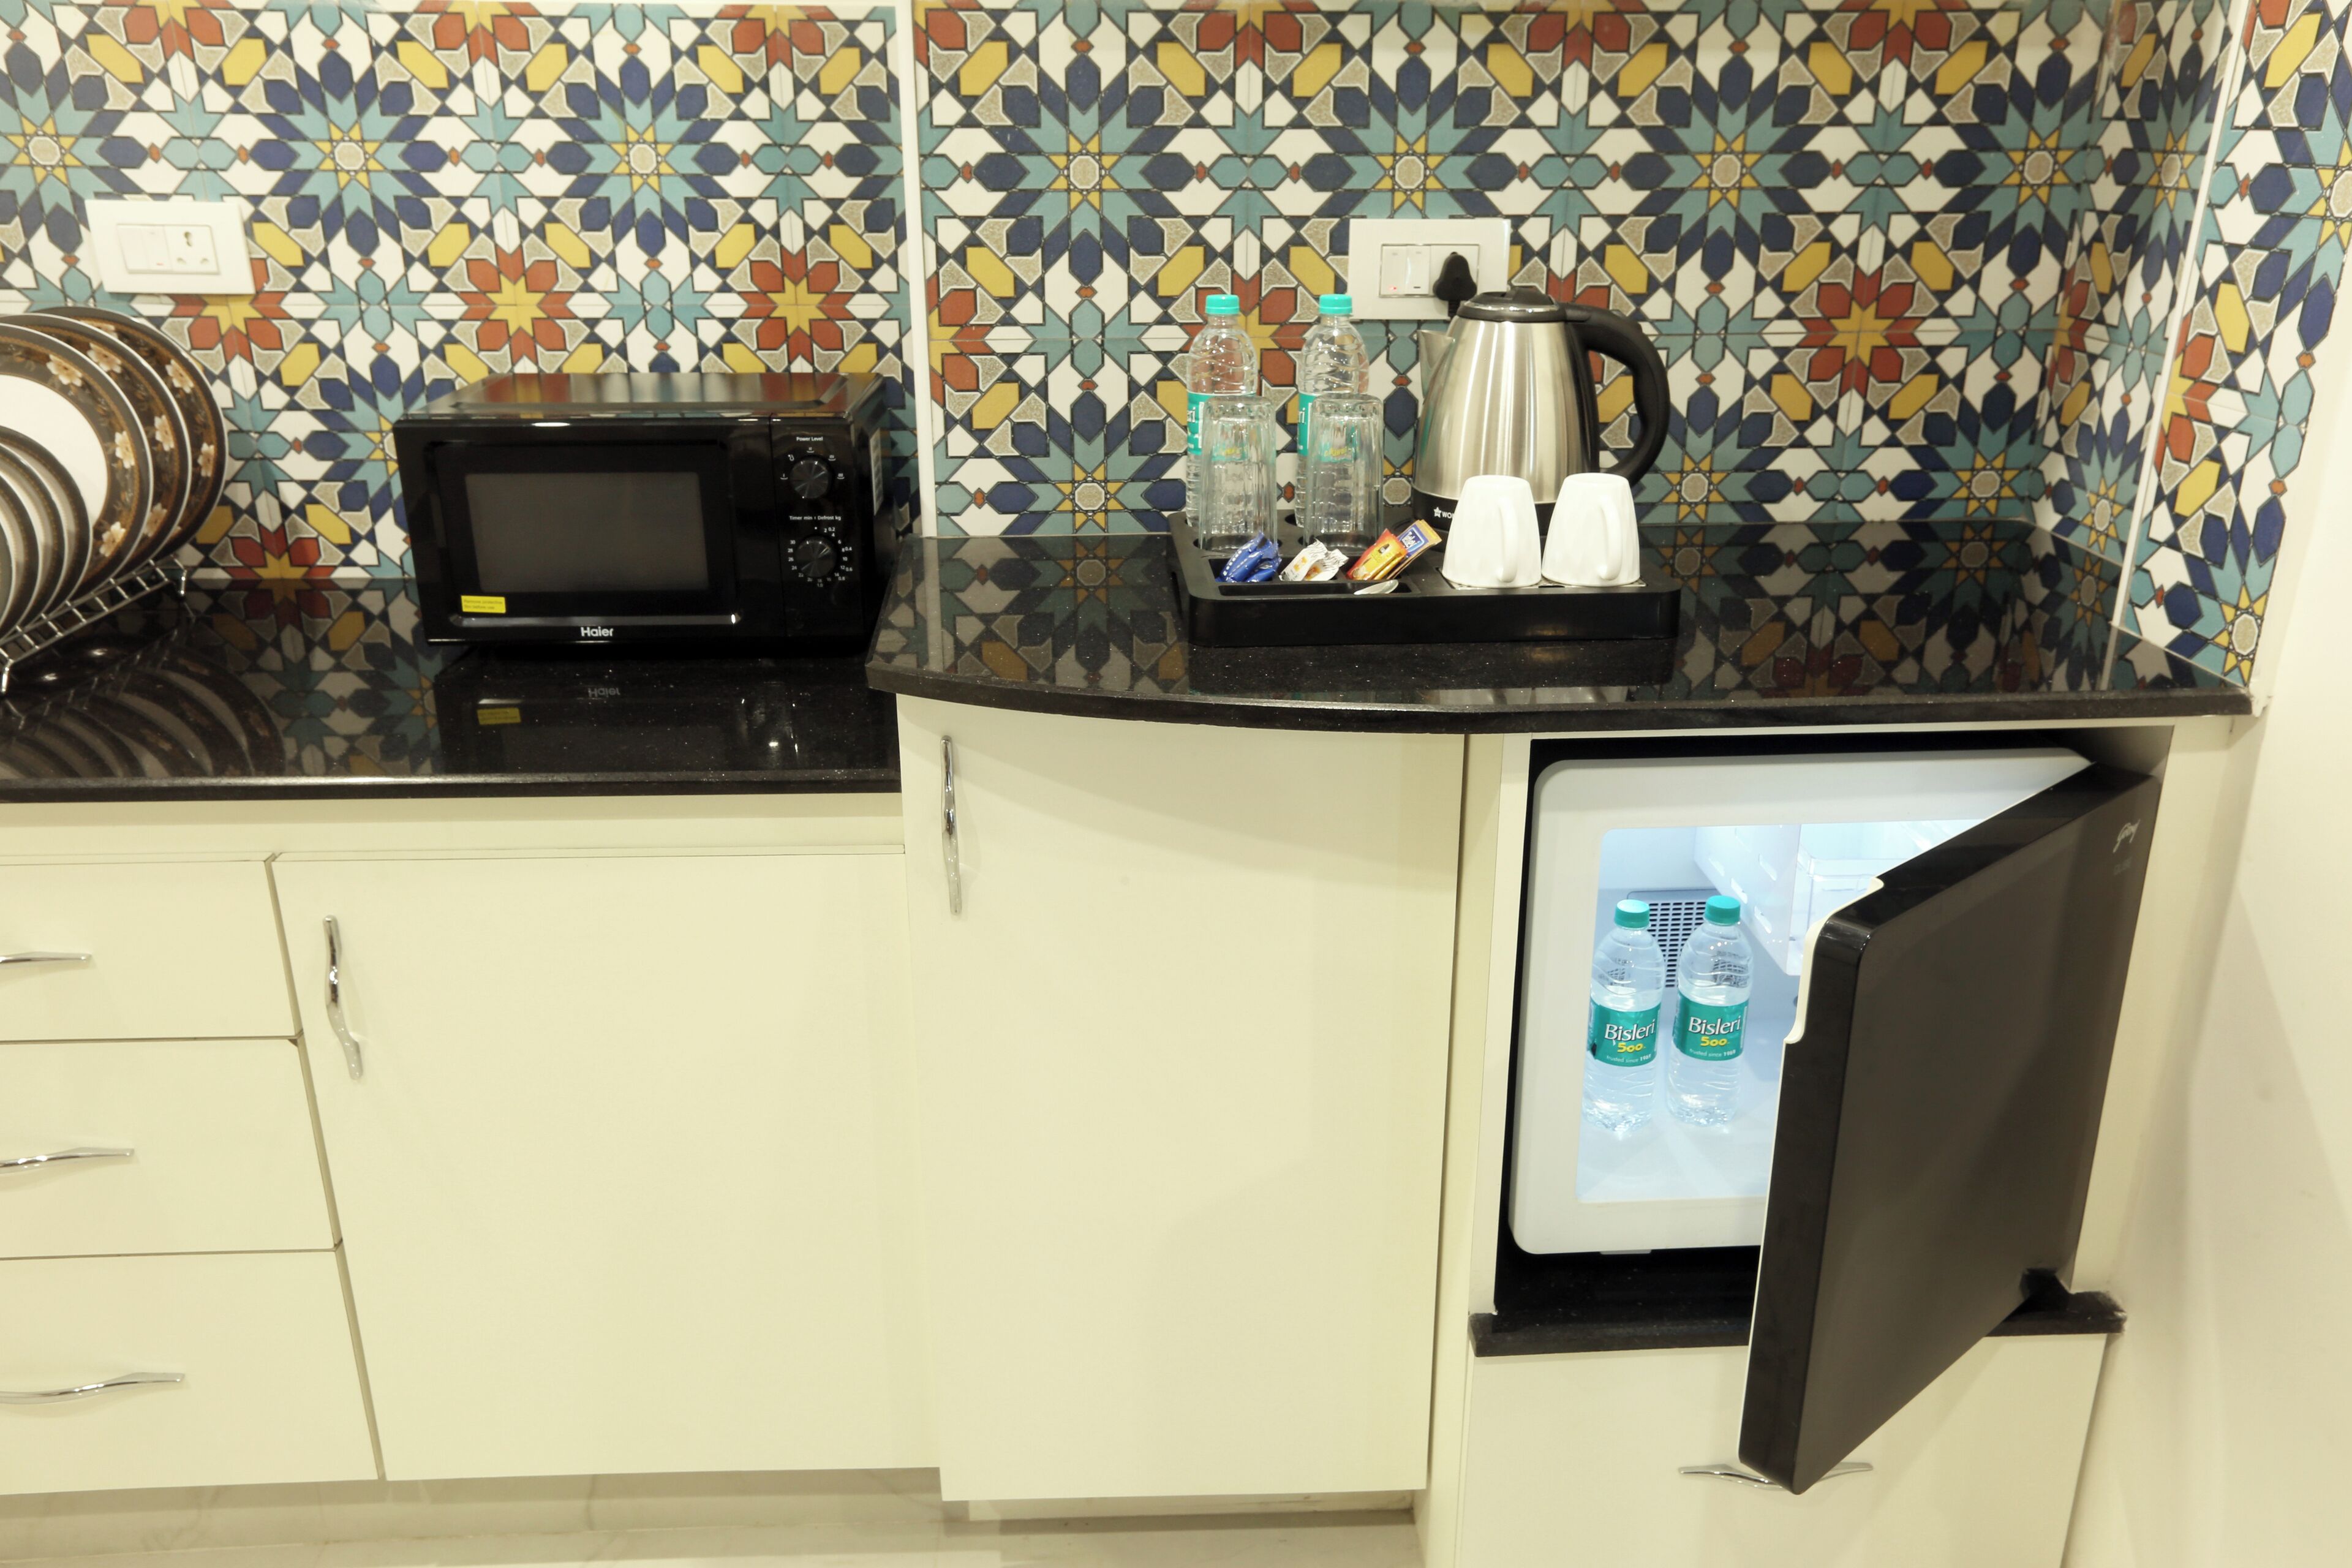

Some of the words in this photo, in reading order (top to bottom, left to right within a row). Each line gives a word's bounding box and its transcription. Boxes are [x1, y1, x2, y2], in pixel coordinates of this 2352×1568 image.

[581, 626, 614, 637] Haier
[1605, 1019, 1656, 1041] Bisleri
[1688, 1015, 1741, 1035] Bisleri
[1700, 1036, 1727, 1047] 500
[1617, 1042, 1644, 1053] 500
